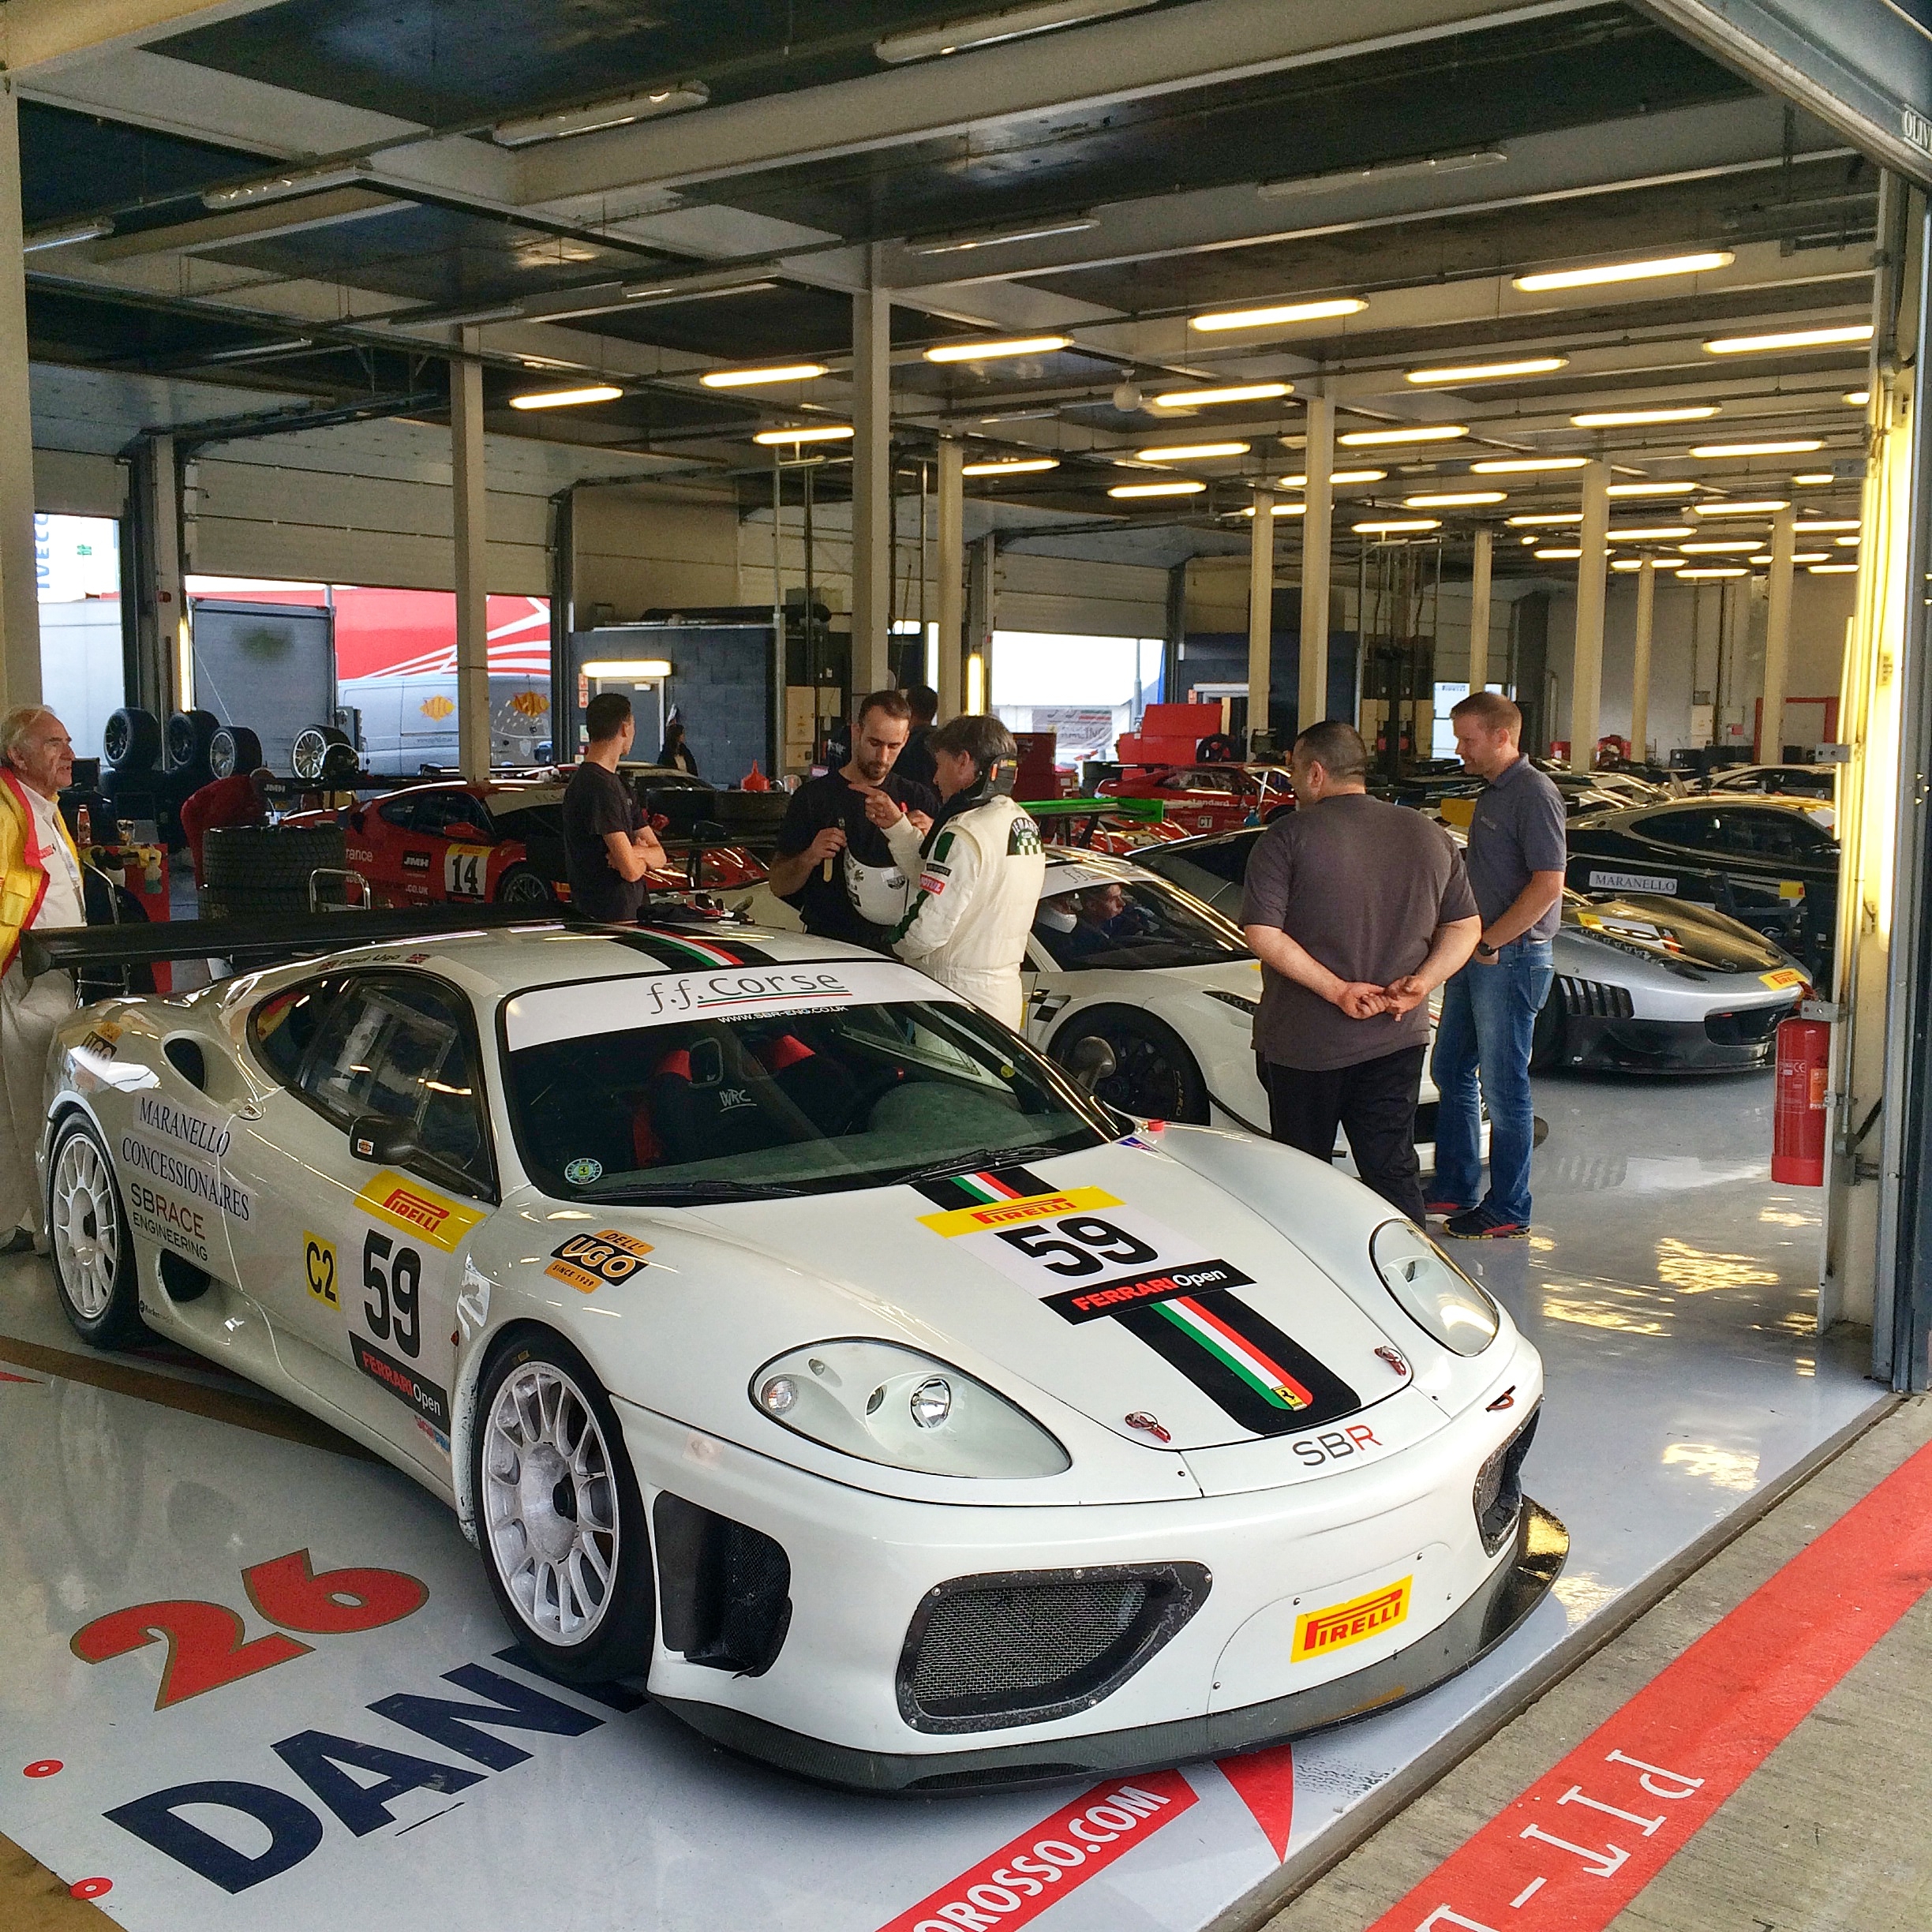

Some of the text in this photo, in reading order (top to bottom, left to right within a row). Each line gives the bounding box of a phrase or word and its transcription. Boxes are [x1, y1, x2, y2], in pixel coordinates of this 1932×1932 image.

[1903, 110, 1932, 153] OLIV
[452, 854, 478, 894] 14
[1596, 874, 1676, 892] MARANELLO
[719, 1089, 751, 1107] WRC
[140, 1097, 230, 1157] MARANELLO
[122, 1137, 249, 1221] CONCESSIONAIRES
[131, 1183, 205, 1240] SBRACE
[382, 1188, 450, 1233] PIRELLI
[970, 1197, 1077, 1224] PIRELLI
[133, 1211, 208, 1262] ENGINEERING
[562, 1237, 636, 1278] UGO
[605, 1233, 644, 1251] DELL'
[994, 1216, 1159, 1277] 59
[306, 1241, 336, 1302] C2
[552, 1264, 575, 1277] SINCE
[363, 1229, 421, 1358] 59
[1292, 1425, 1383, 1466] SBR
[69, 1548, 429, 1711] 26
[1304, 1589, 1403, 1651] PIRELLI
